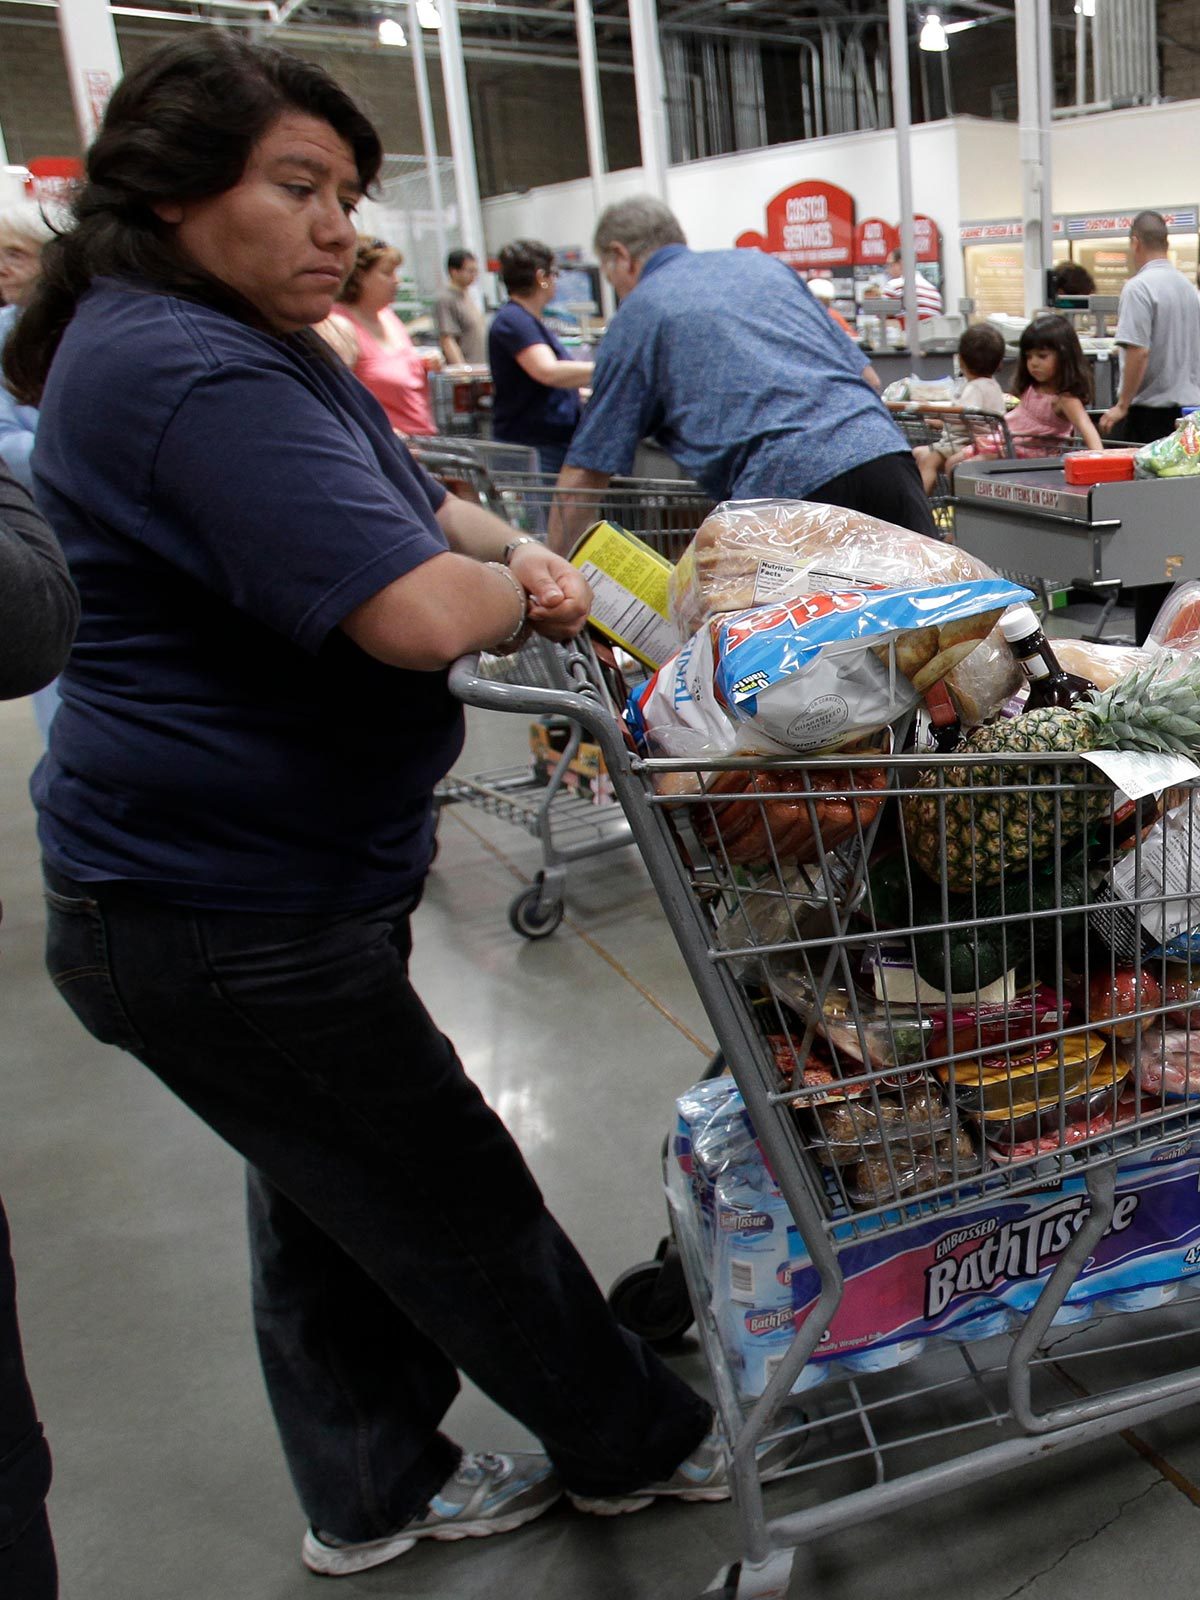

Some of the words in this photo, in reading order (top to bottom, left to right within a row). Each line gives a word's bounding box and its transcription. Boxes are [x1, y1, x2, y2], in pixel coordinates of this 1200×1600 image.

[785, 195, 828, 223] COSTCO
[1084, 218, 1115, 230] CUSTOM
[783, 221, 833, 250] SERVICES
[976, 481, 993, 496] LEAVE
[994, 484, 1012, 499] HEAVY
[1014, 487, 1031, 503] ITEMS
[1032, 489, 1041, 504] ON
[1041, 490, 1058, 507] CART
[760, 568, 782, 578] Facts
[761, 561, 795, 573] Nutrition
[794, 706, 842, 732] GUARANTEED
[807, 720, 832, 732] FRESH
[721, 1215, 767, 1230] BathTissue
[935, 1217, 996, 1260] EMBOSSED
[839, 1335, 868, 1347] Wrapped
